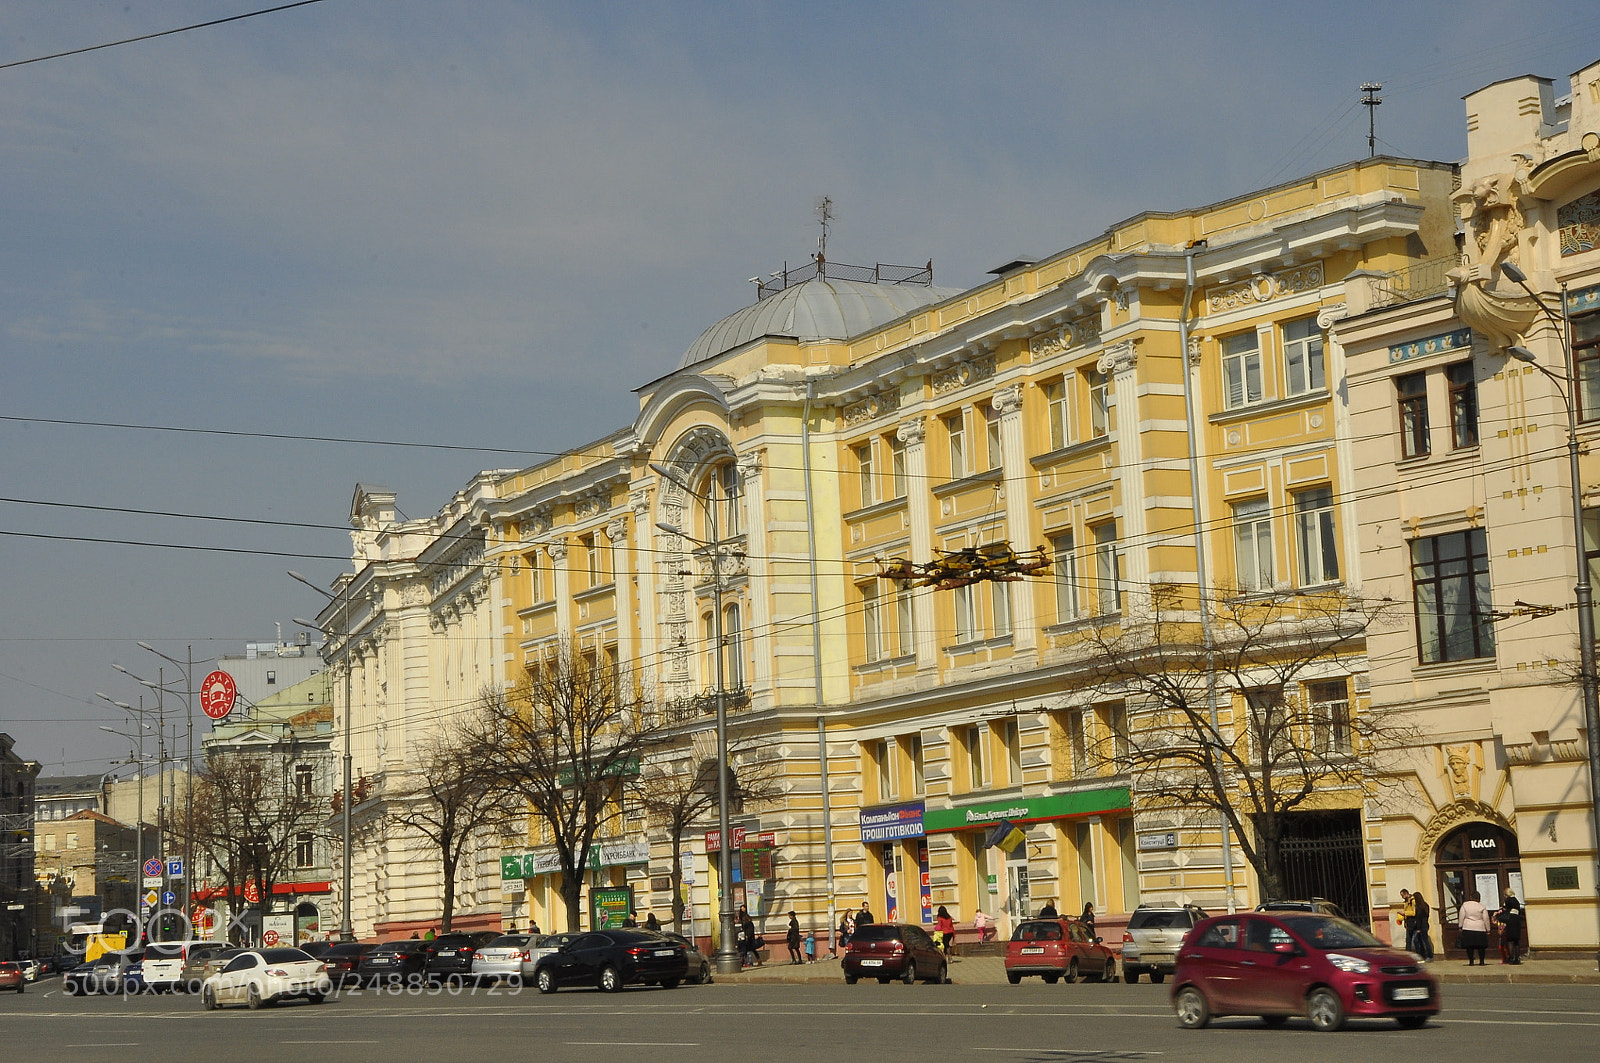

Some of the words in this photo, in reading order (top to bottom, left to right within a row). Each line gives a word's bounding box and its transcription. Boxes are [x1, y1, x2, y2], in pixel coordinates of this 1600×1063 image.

[202, 673, 232, 698] ПУЗАТА
[207, 702, 230, 716] ХАТА
[862, 827, 885, 840] ГРОШІ
[885, 822, 923, 838] ГОТІВКОЮ
[1470, 838, 1497, 849] КАСА
